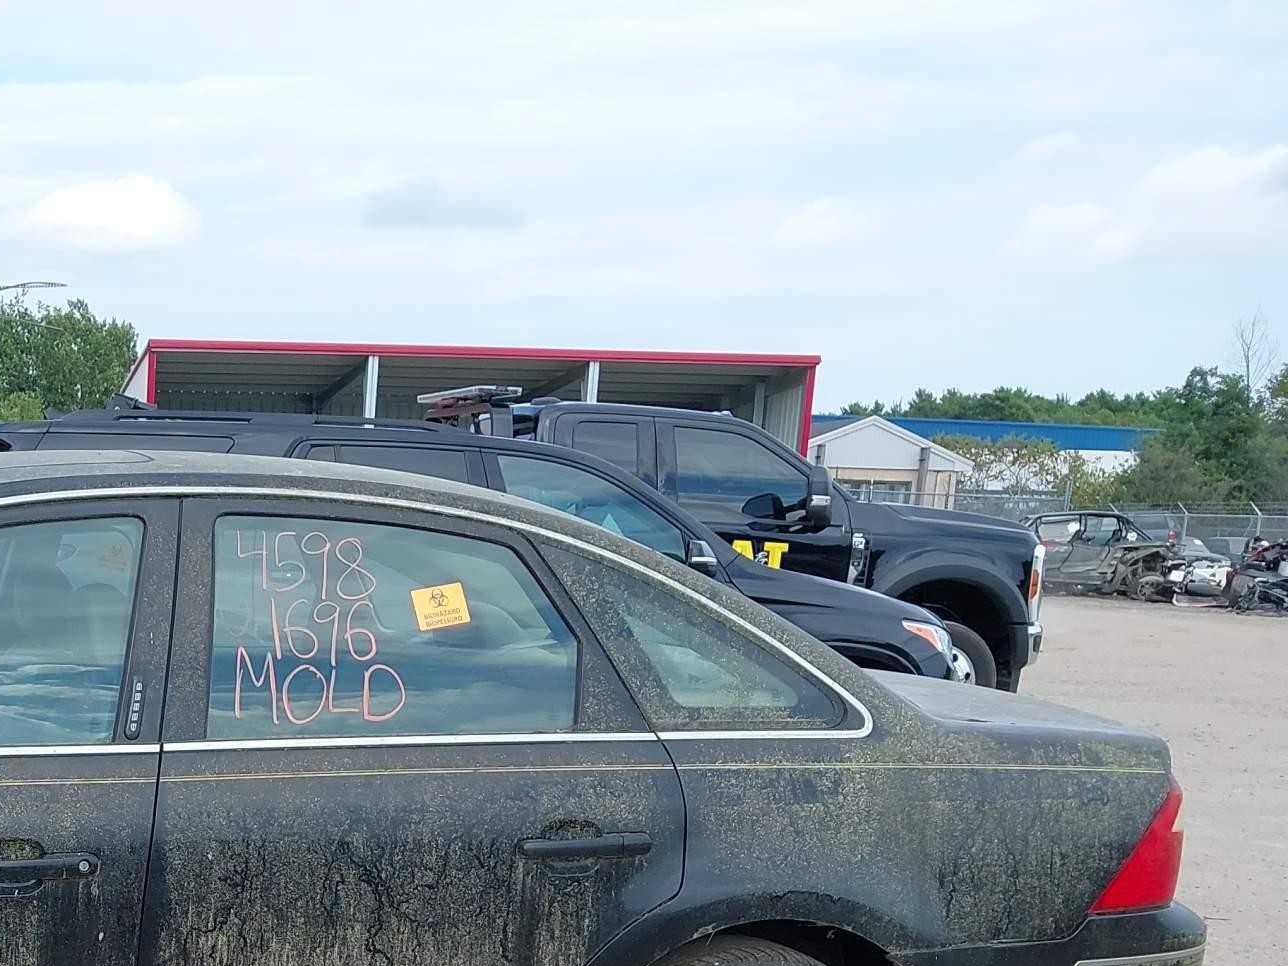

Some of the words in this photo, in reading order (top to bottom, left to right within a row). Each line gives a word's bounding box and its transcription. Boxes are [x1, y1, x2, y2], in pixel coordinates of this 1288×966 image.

[236, 528, 377, 600] 4598
[271, 597, 377, 667] 1696
[235, 646, 406, 725] MOLD
